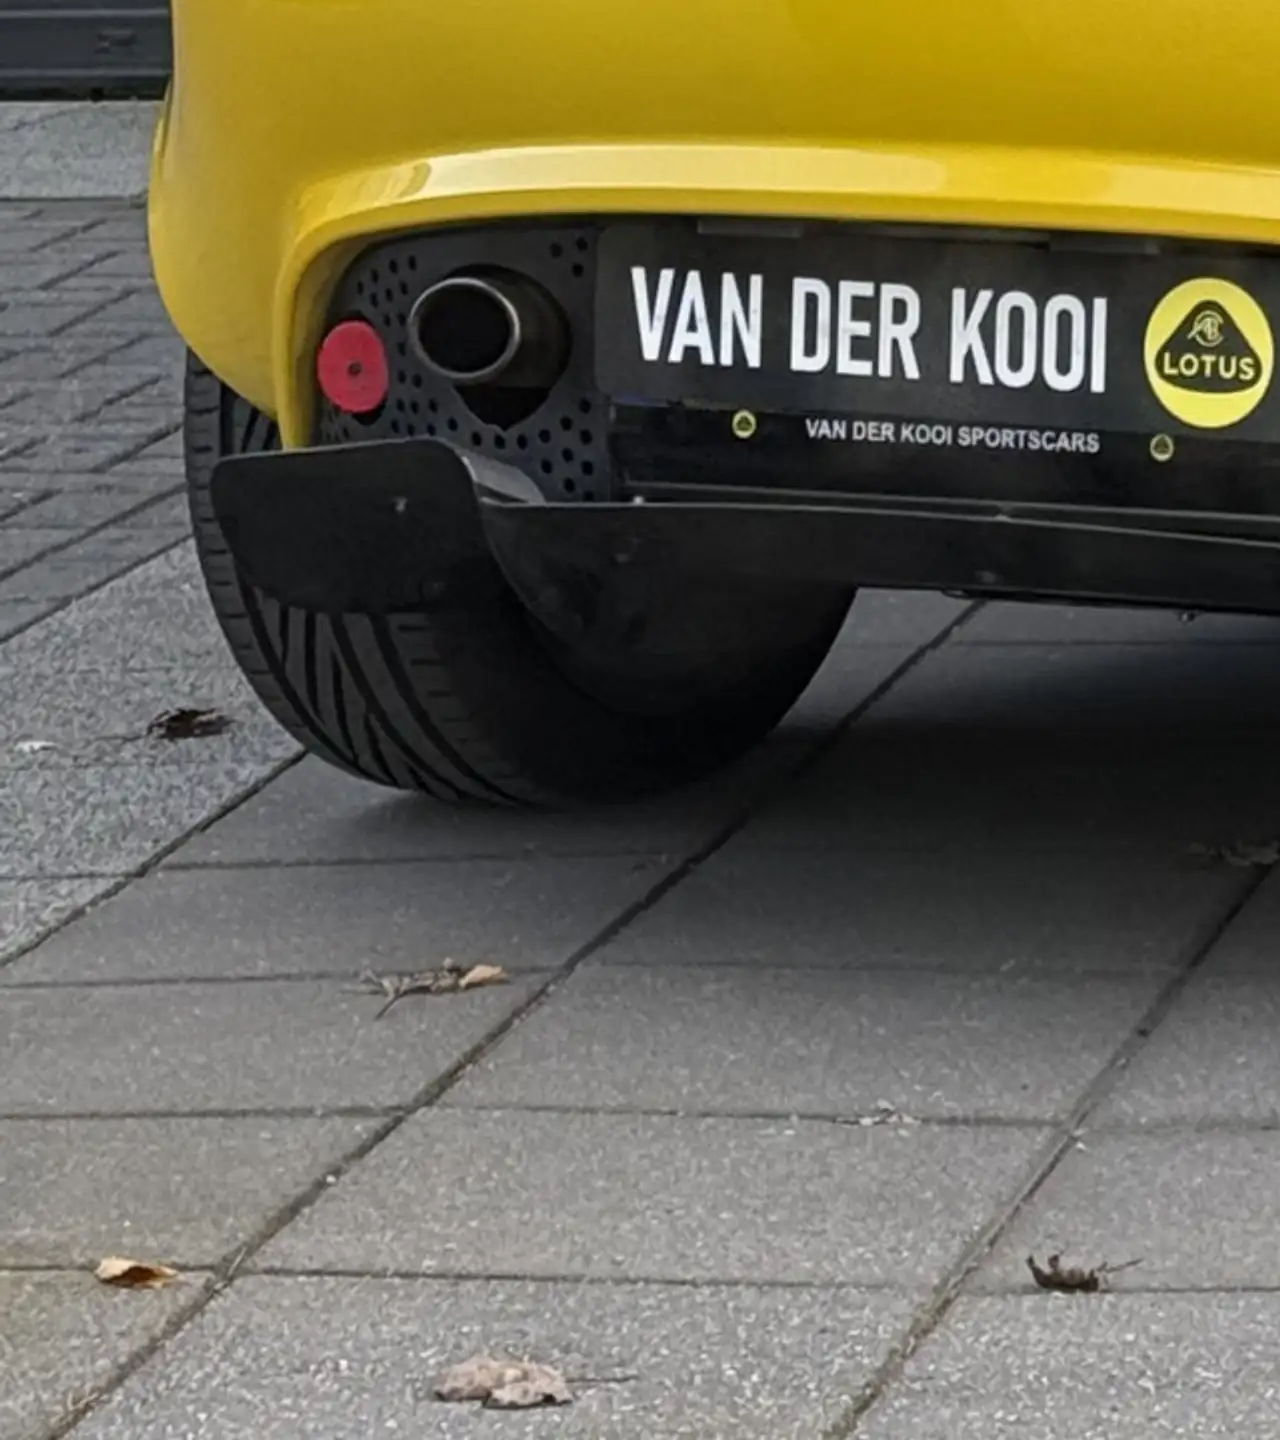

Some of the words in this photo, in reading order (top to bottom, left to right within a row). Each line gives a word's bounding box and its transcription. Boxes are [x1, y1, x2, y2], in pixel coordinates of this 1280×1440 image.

[631, 266, 763, 368] VAN
[790, 277, 920, 380] DER
[949, 287, 1107, 393] KOOI
[1163, 352, 1256, 380] LOTUS
[805, 418, 847, 440] VAN
[852, 421, 896, 443] DER
[900, 424, 953, 446] KOOI
[957, 426, 1101, 454] SPORTSCARS
